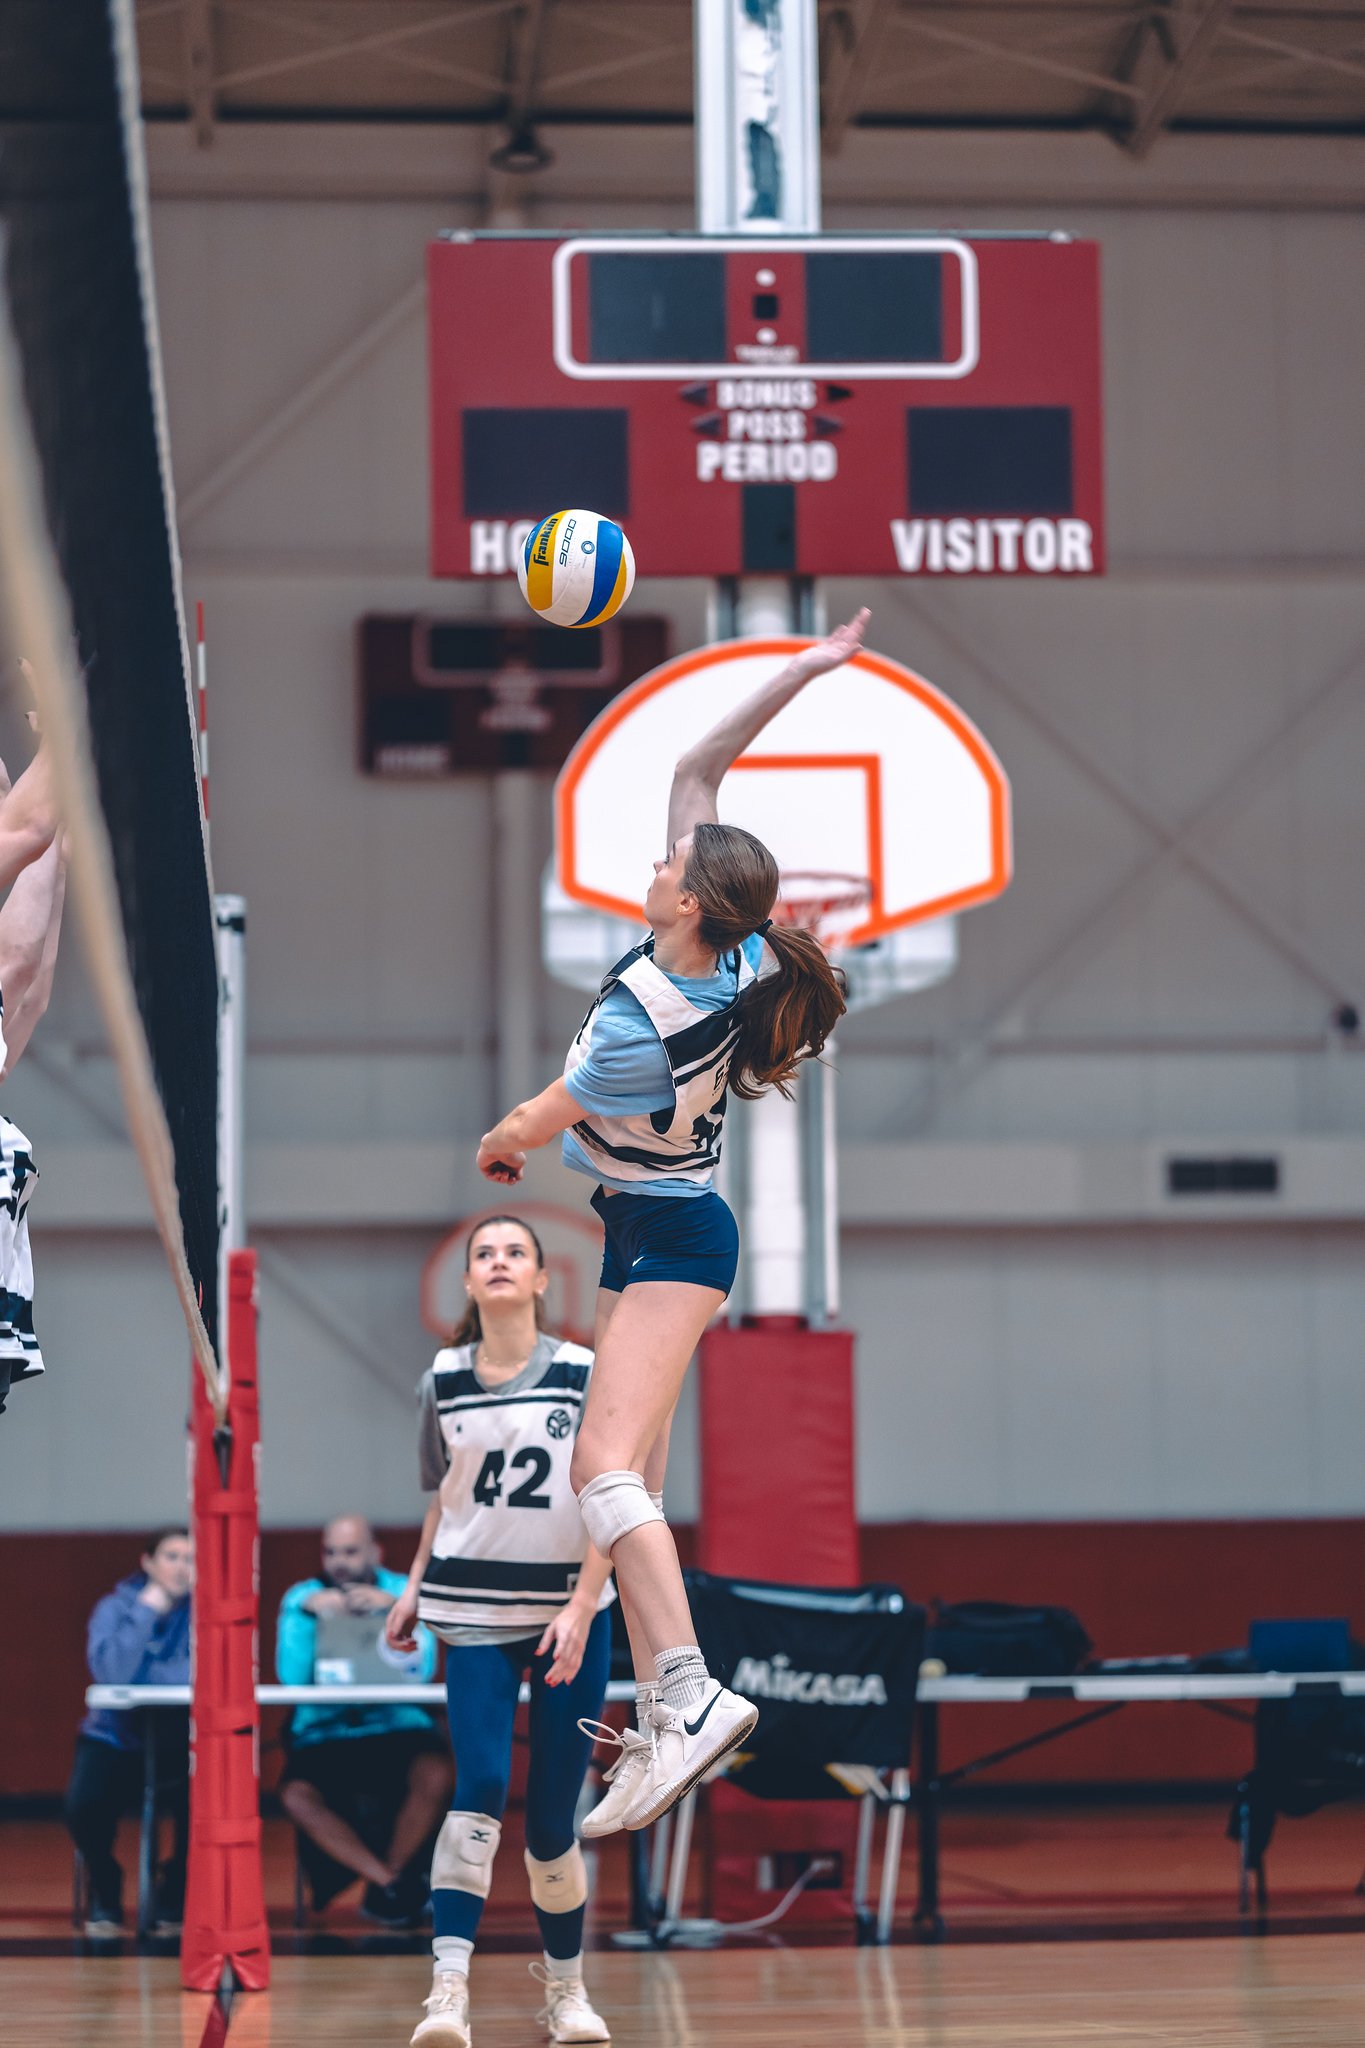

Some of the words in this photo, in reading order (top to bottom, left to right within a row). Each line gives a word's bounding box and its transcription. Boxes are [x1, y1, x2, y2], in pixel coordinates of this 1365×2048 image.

[717, 379, 816, 409] BONUS
[728, 410, 806, 440] POSS
[696, 440, 837, 481] PERIOD
[533, 518, 559, 566] franklin
[559, 518, 577, 568] 9000
[889, 517, 1093, 573] VISITOR
[473, 1446, 551, 1509] 42
